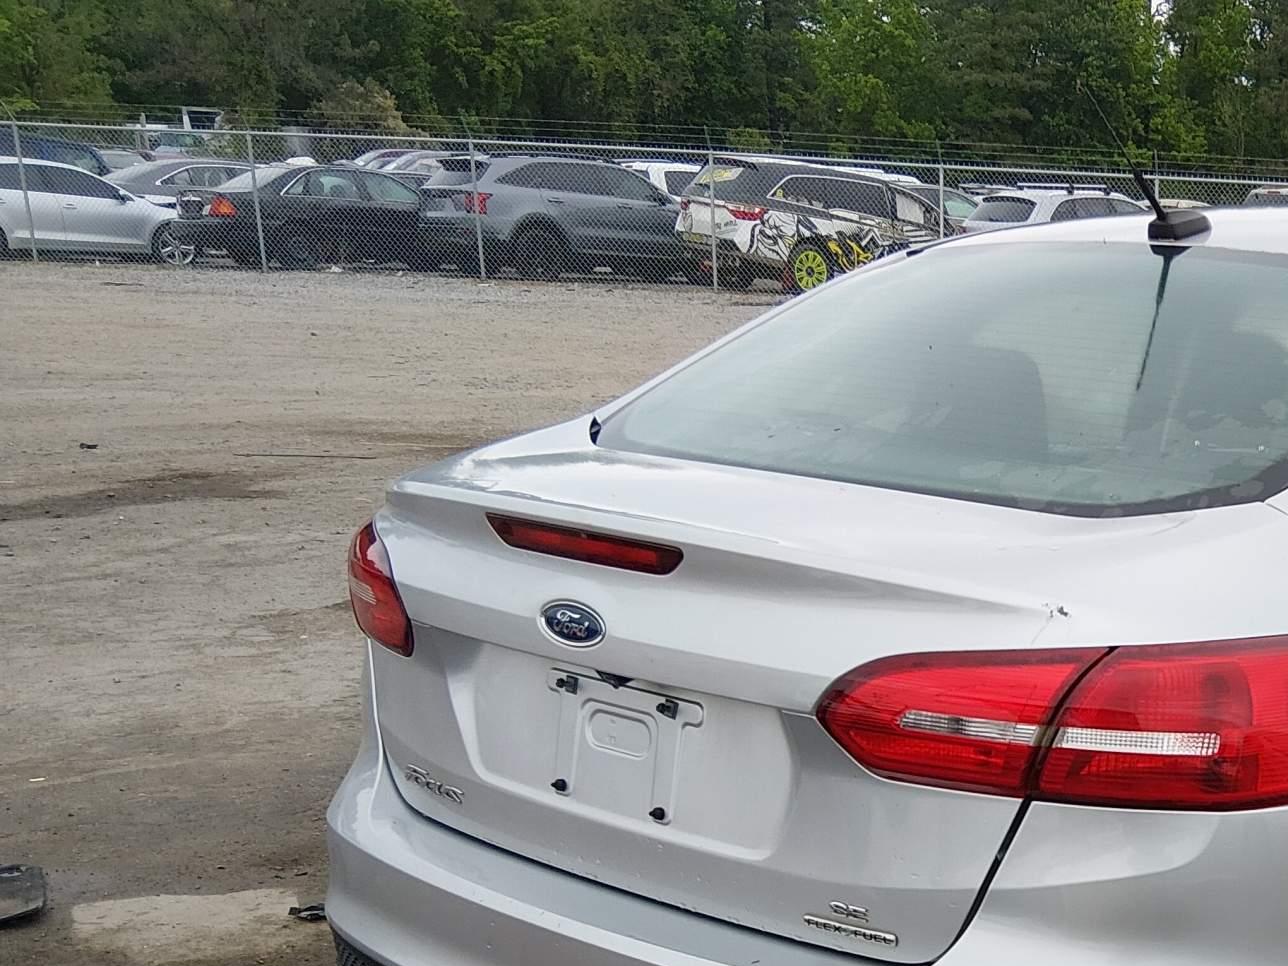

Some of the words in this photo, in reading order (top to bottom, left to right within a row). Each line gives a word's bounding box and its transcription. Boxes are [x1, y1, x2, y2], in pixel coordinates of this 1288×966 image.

[552, 609, 590, 638] Ford
[828, 899, 870, 923] SE
[803, 917, 842, 935] FLEX
[853, 930, 896, 946] FUEL
